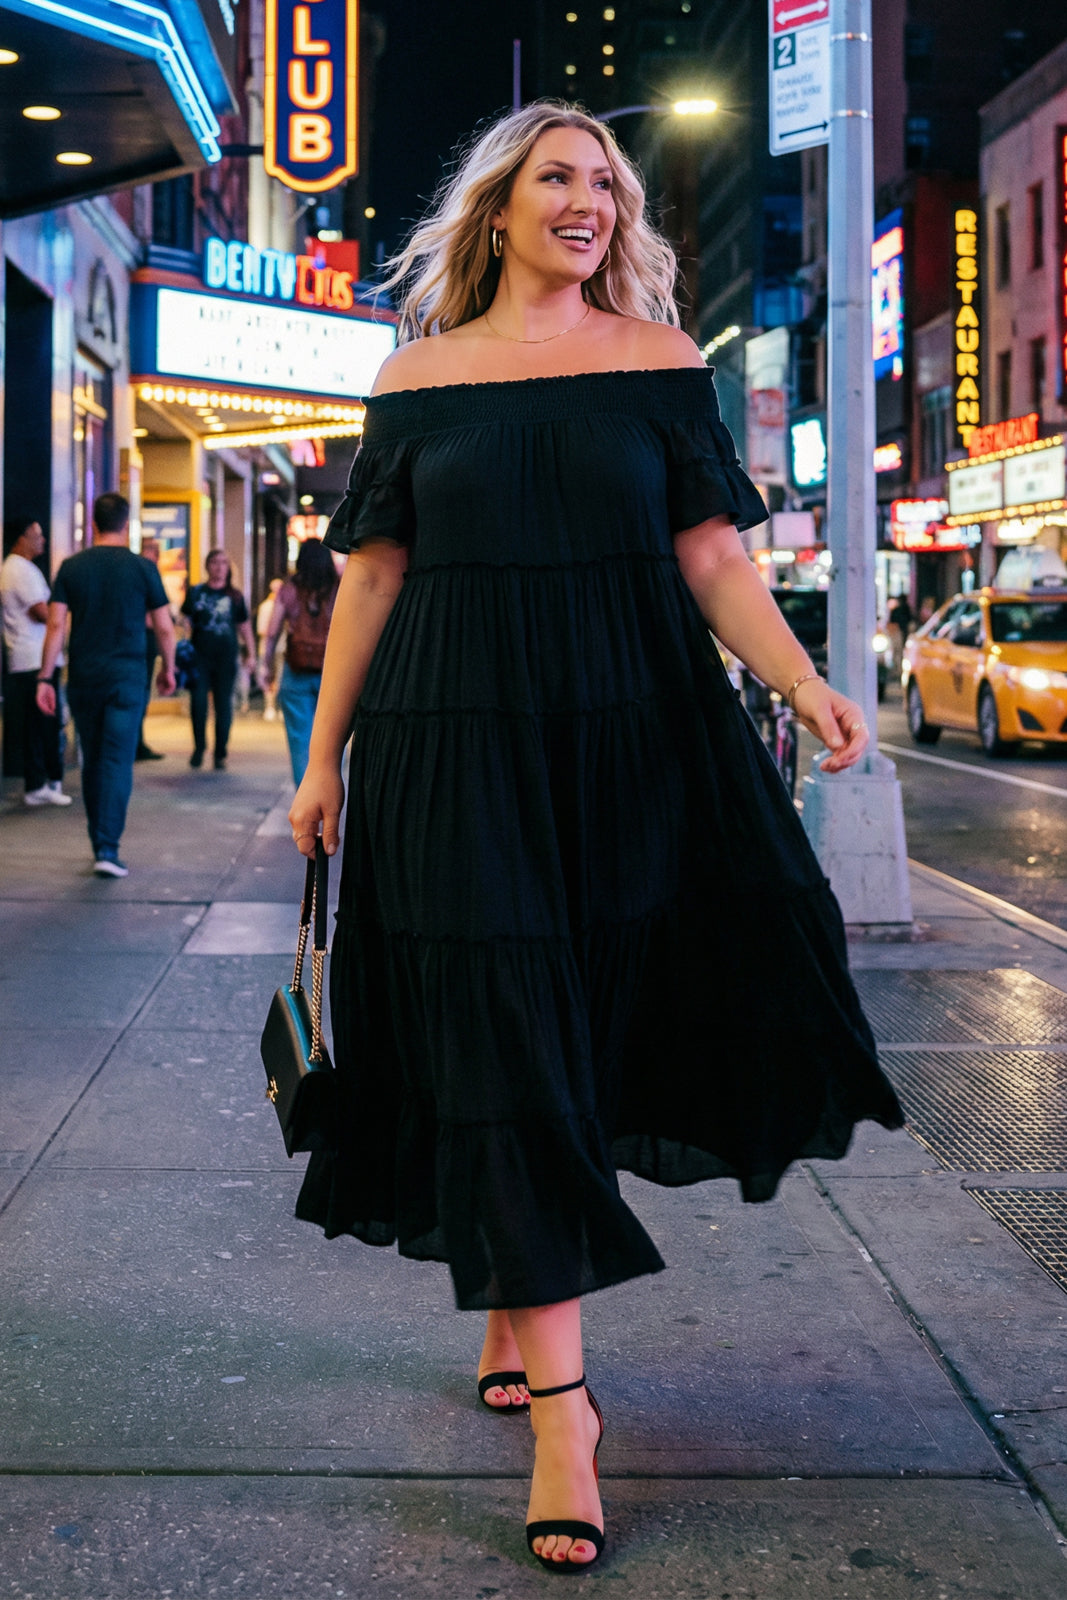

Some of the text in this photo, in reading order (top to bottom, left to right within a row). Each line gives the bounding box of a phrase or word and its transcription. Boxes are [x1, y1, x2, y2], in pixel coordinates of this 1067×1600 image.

[287, 0, 334, 163] LUB
[778, 37, 792, 66] 2
[954, 209, 980, 447] RESTAURANT
